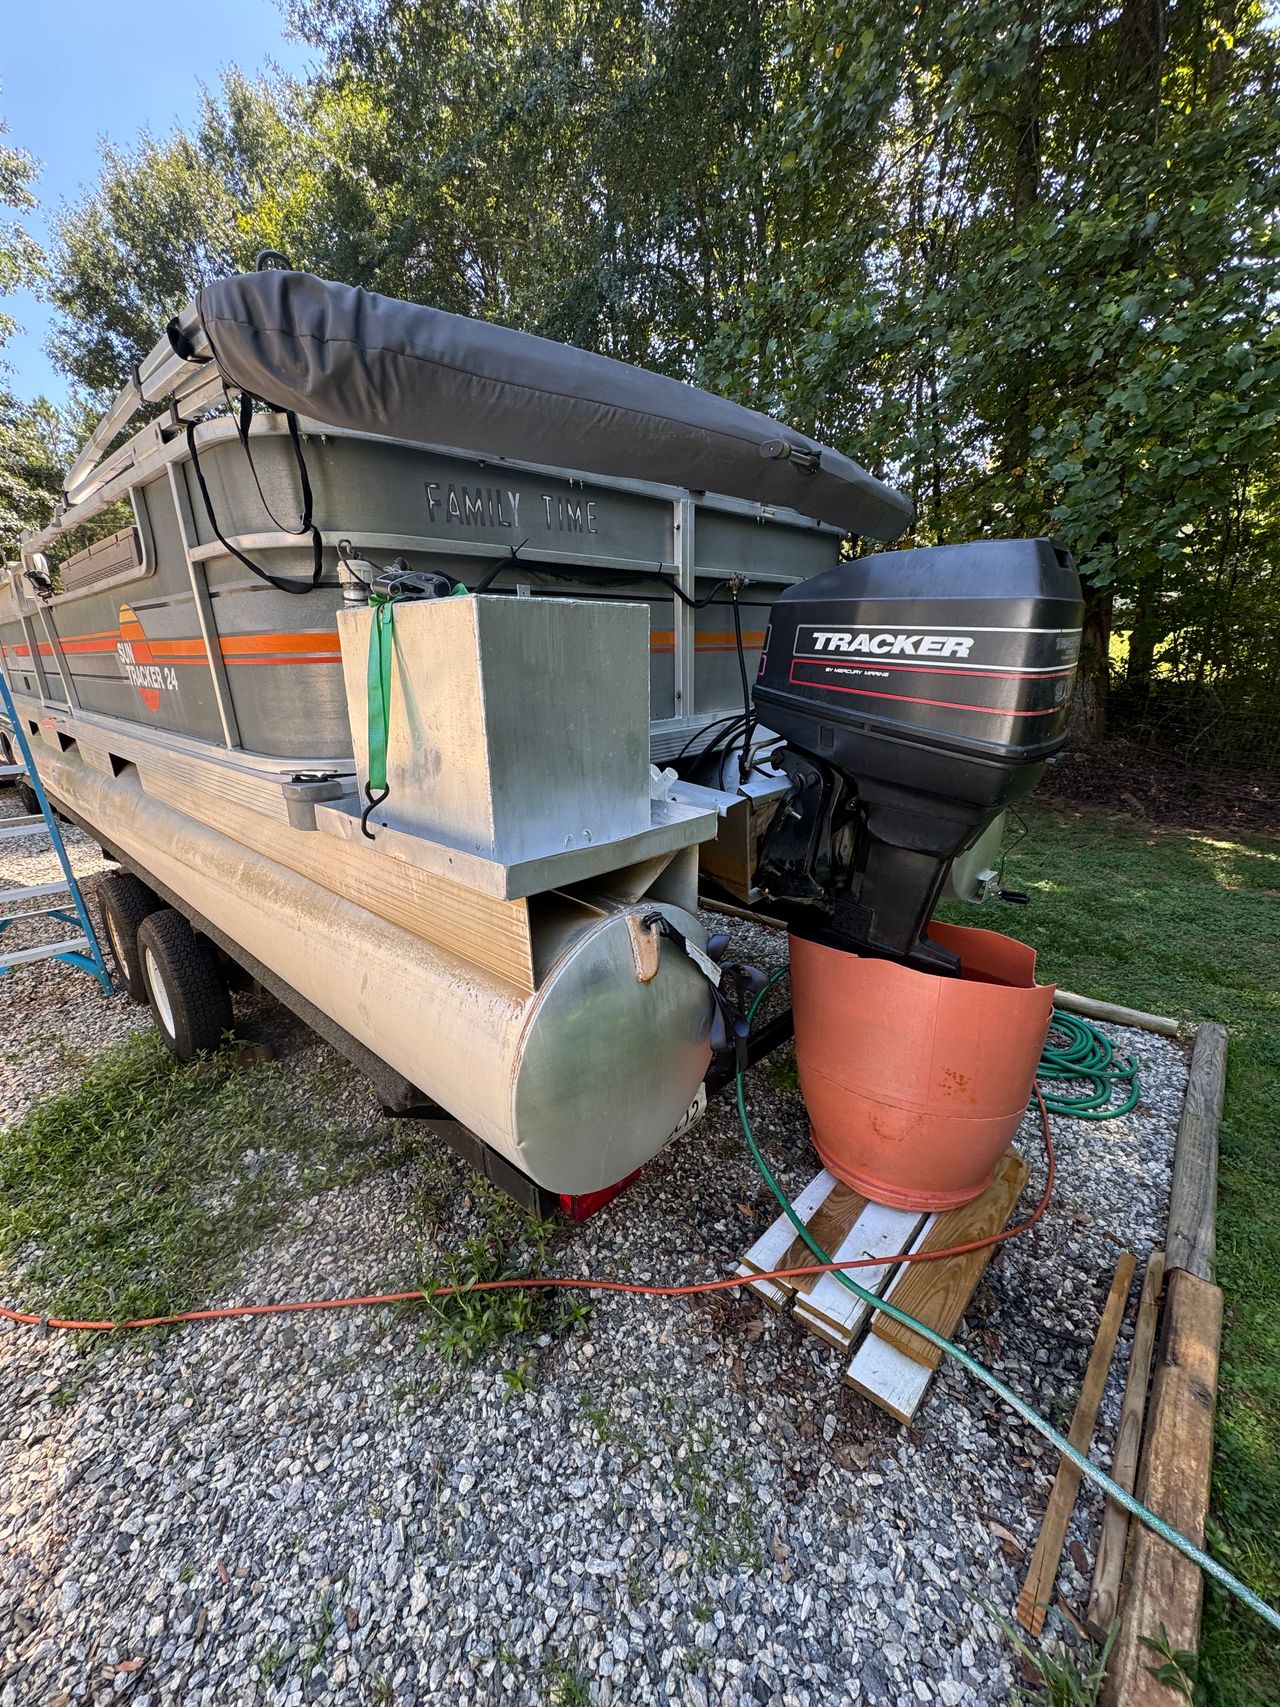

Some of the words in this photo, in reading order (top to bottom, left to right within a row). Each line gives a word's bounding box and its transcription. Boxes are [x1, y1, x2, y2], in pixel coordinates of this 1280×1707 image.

[424, 481, 520, 528] FAMILY
[541, 494, 598, 534] TIME
[117, 642, 135, 664] SUN
[812, 632, 975, 658] TRACKER
[125, 665, 166, 689] TRACKER
[164, 667, 179, 690] 24
